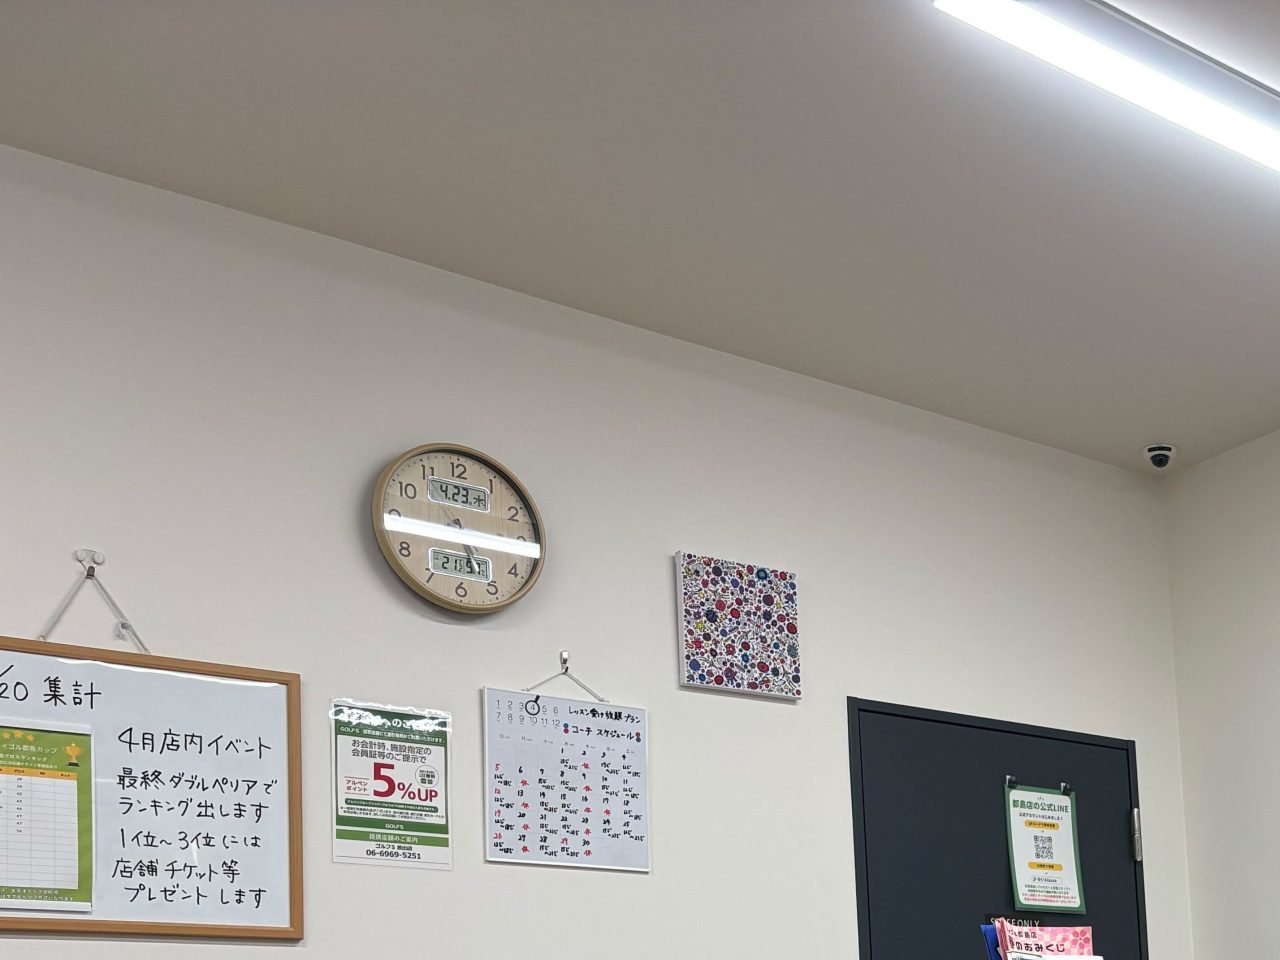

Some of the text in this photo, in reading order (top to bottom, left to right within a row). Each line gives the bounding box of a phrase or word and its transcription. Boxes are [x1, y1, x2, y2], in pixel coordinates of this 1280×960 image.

[450, 462, 468, 480] 12
[399, 481, 417, 500] 10
[507, 506, 520, 522] 2
[398, 541, 411, 558] 8
[507, 563, 519, 578] 4
[455, 581, 468, 598] 6
[43, 676, 102, 709] 集計
[117, 727, 272, 759] 4月店内イベント
[117, 767, 278, 796] 最終ダブルペリアで
[346, 785, 368, 793] ポイント
[119, 797, 270, 823] ランキング出します
[1012, 799, 1068, 813] 都島店の公式LINE
[366, 849, 422, 860] 06-6969-5251
[111, 857, 241, 883] 店舗チケット等
[124, 885, 267, 909] プレゼントします
